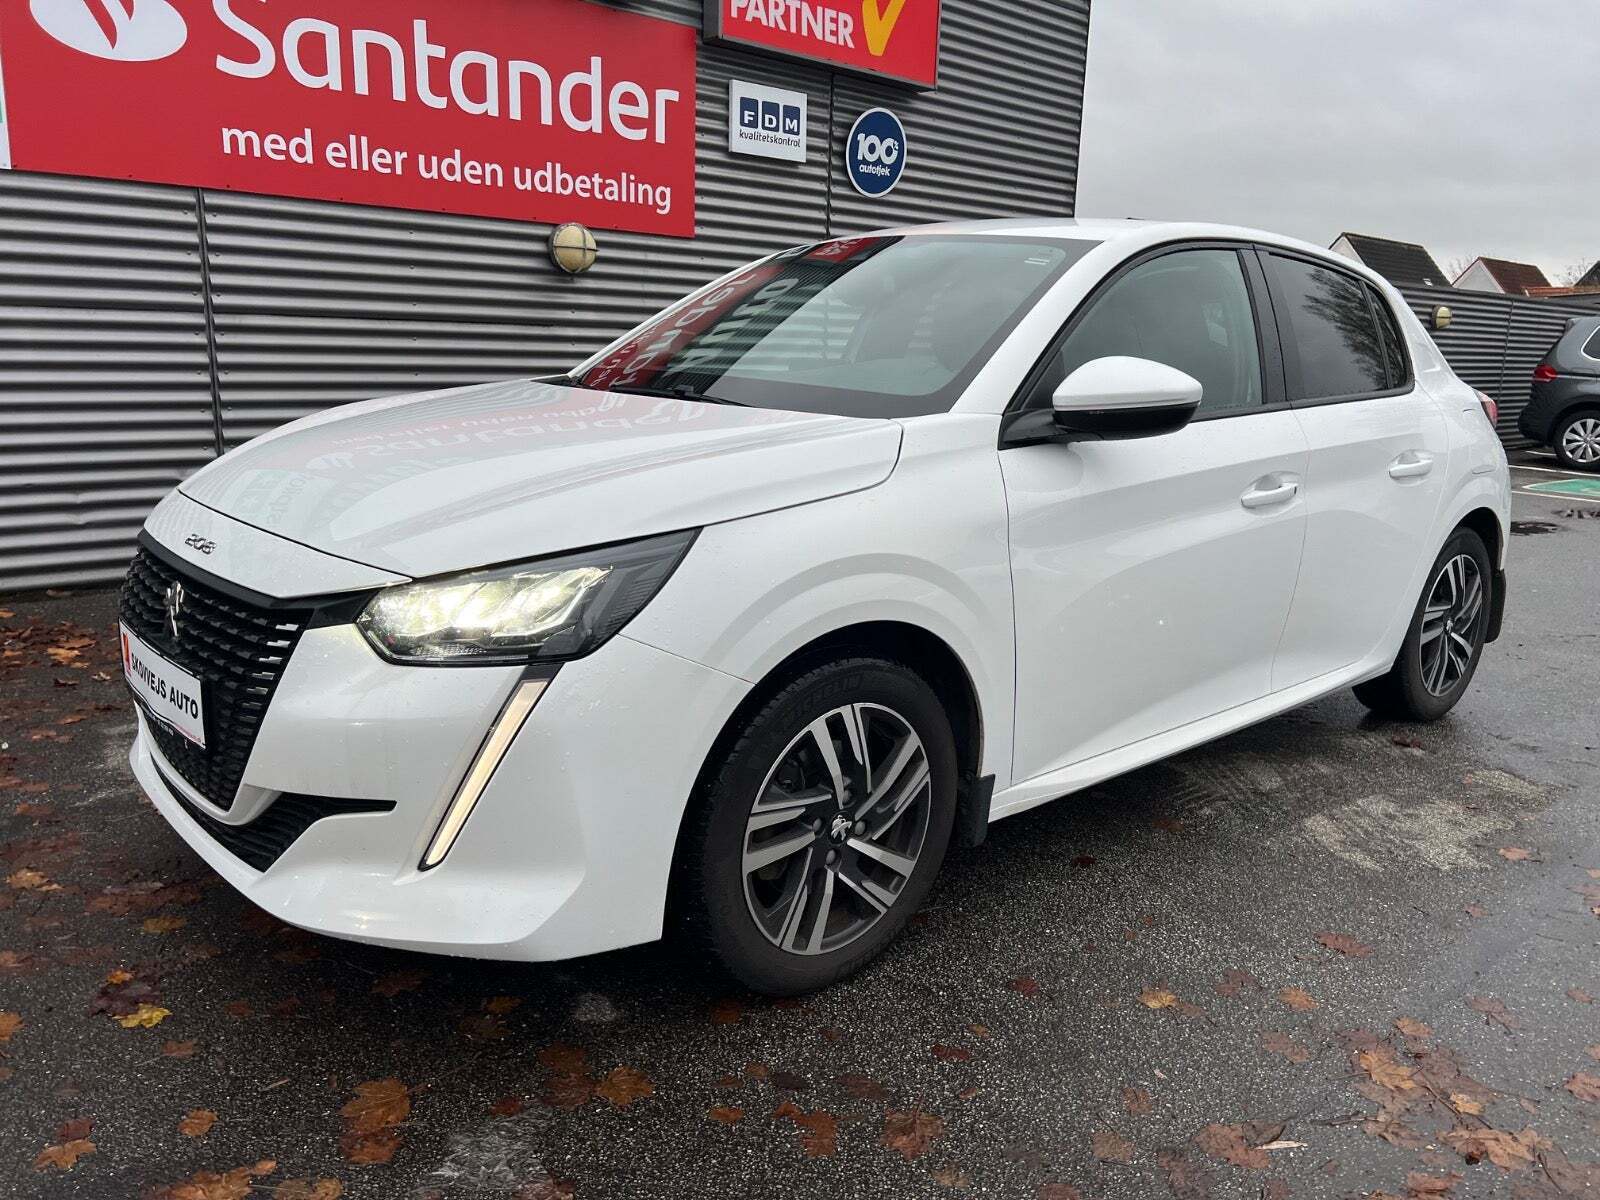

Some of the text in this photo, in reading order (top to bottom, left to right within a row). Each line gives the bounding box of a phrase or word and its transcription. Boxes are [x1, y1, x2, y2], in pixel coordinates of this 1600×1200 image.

[730, 0, 855, 49] PARTNER
[211, 0, 680, 144] Santander
[738, 128, 801, 149] kvalitetskontrol
[742, 109, 799, 133] FDM
[221, 127, 671, 215] med eller uden udbetaling
[859, 163, 891, 177] autotjek
[169, 685, 199, 720] AUTO
